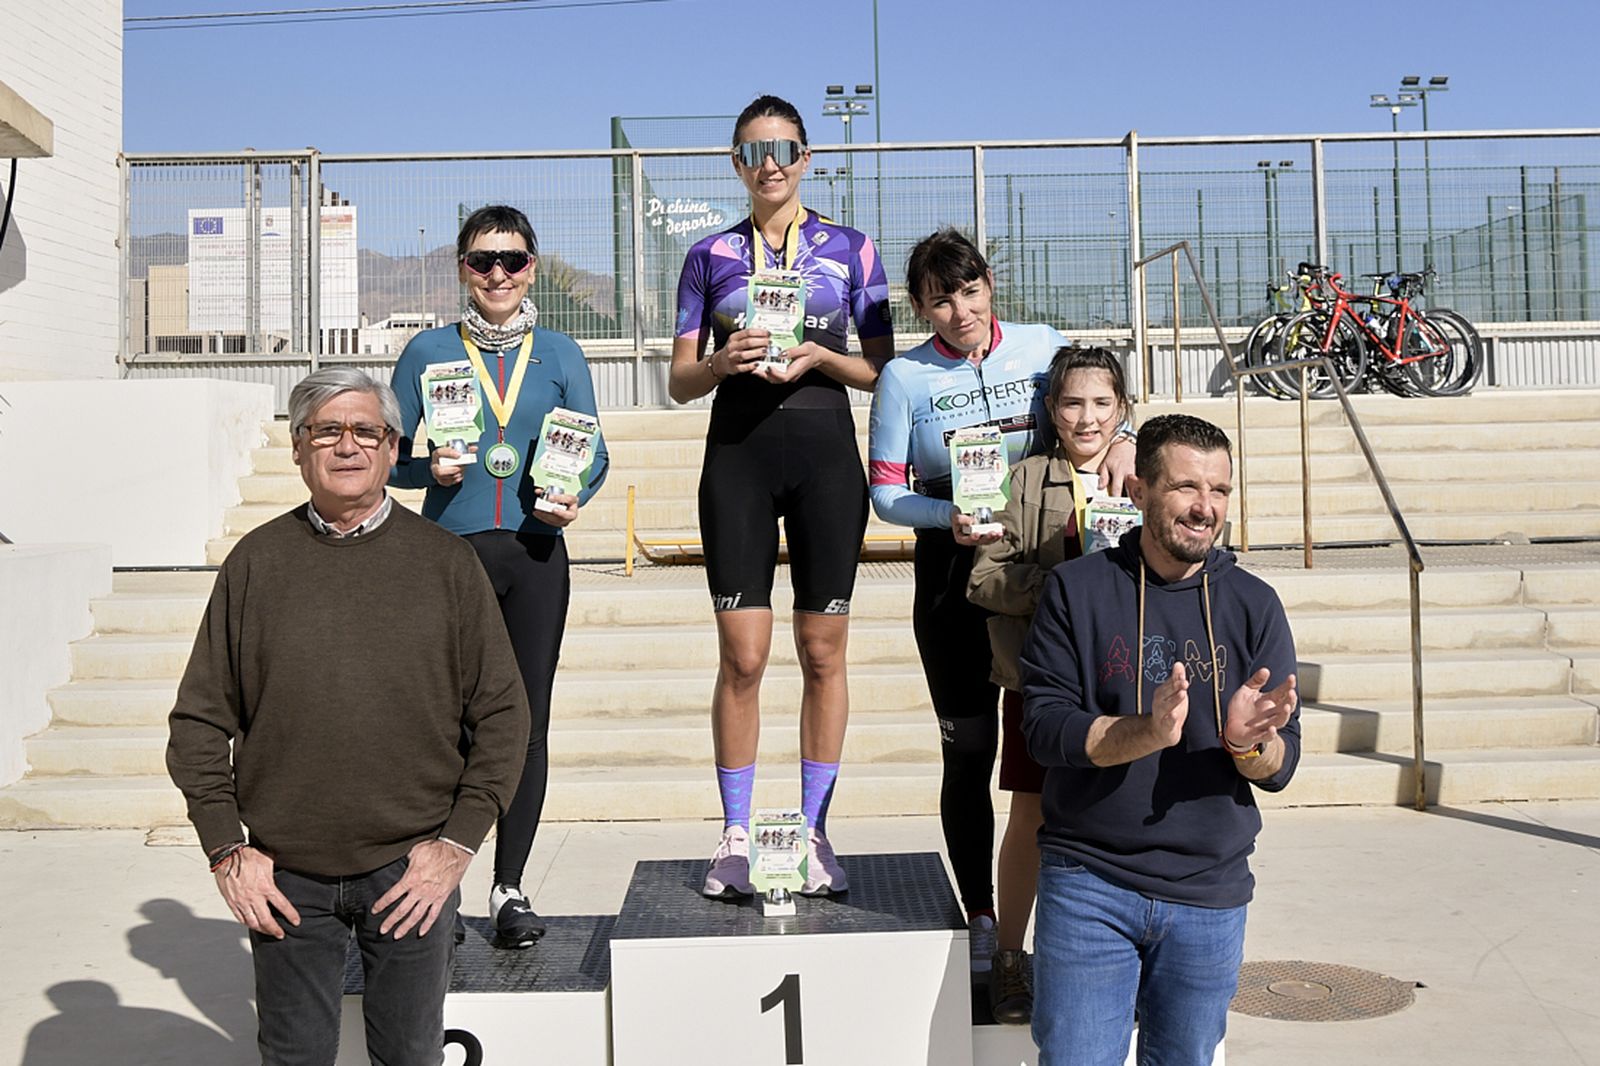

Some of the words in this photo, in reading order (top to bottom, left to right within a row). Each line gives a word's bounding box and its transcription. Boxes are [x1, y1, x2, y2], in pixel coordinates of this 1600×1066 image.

[652, 216, 663, 227] es
[666, 211, 724, 238] deporte
[929, 378, 1029, 412] KOPPERT
[760, 973, 804, 1065] 1
